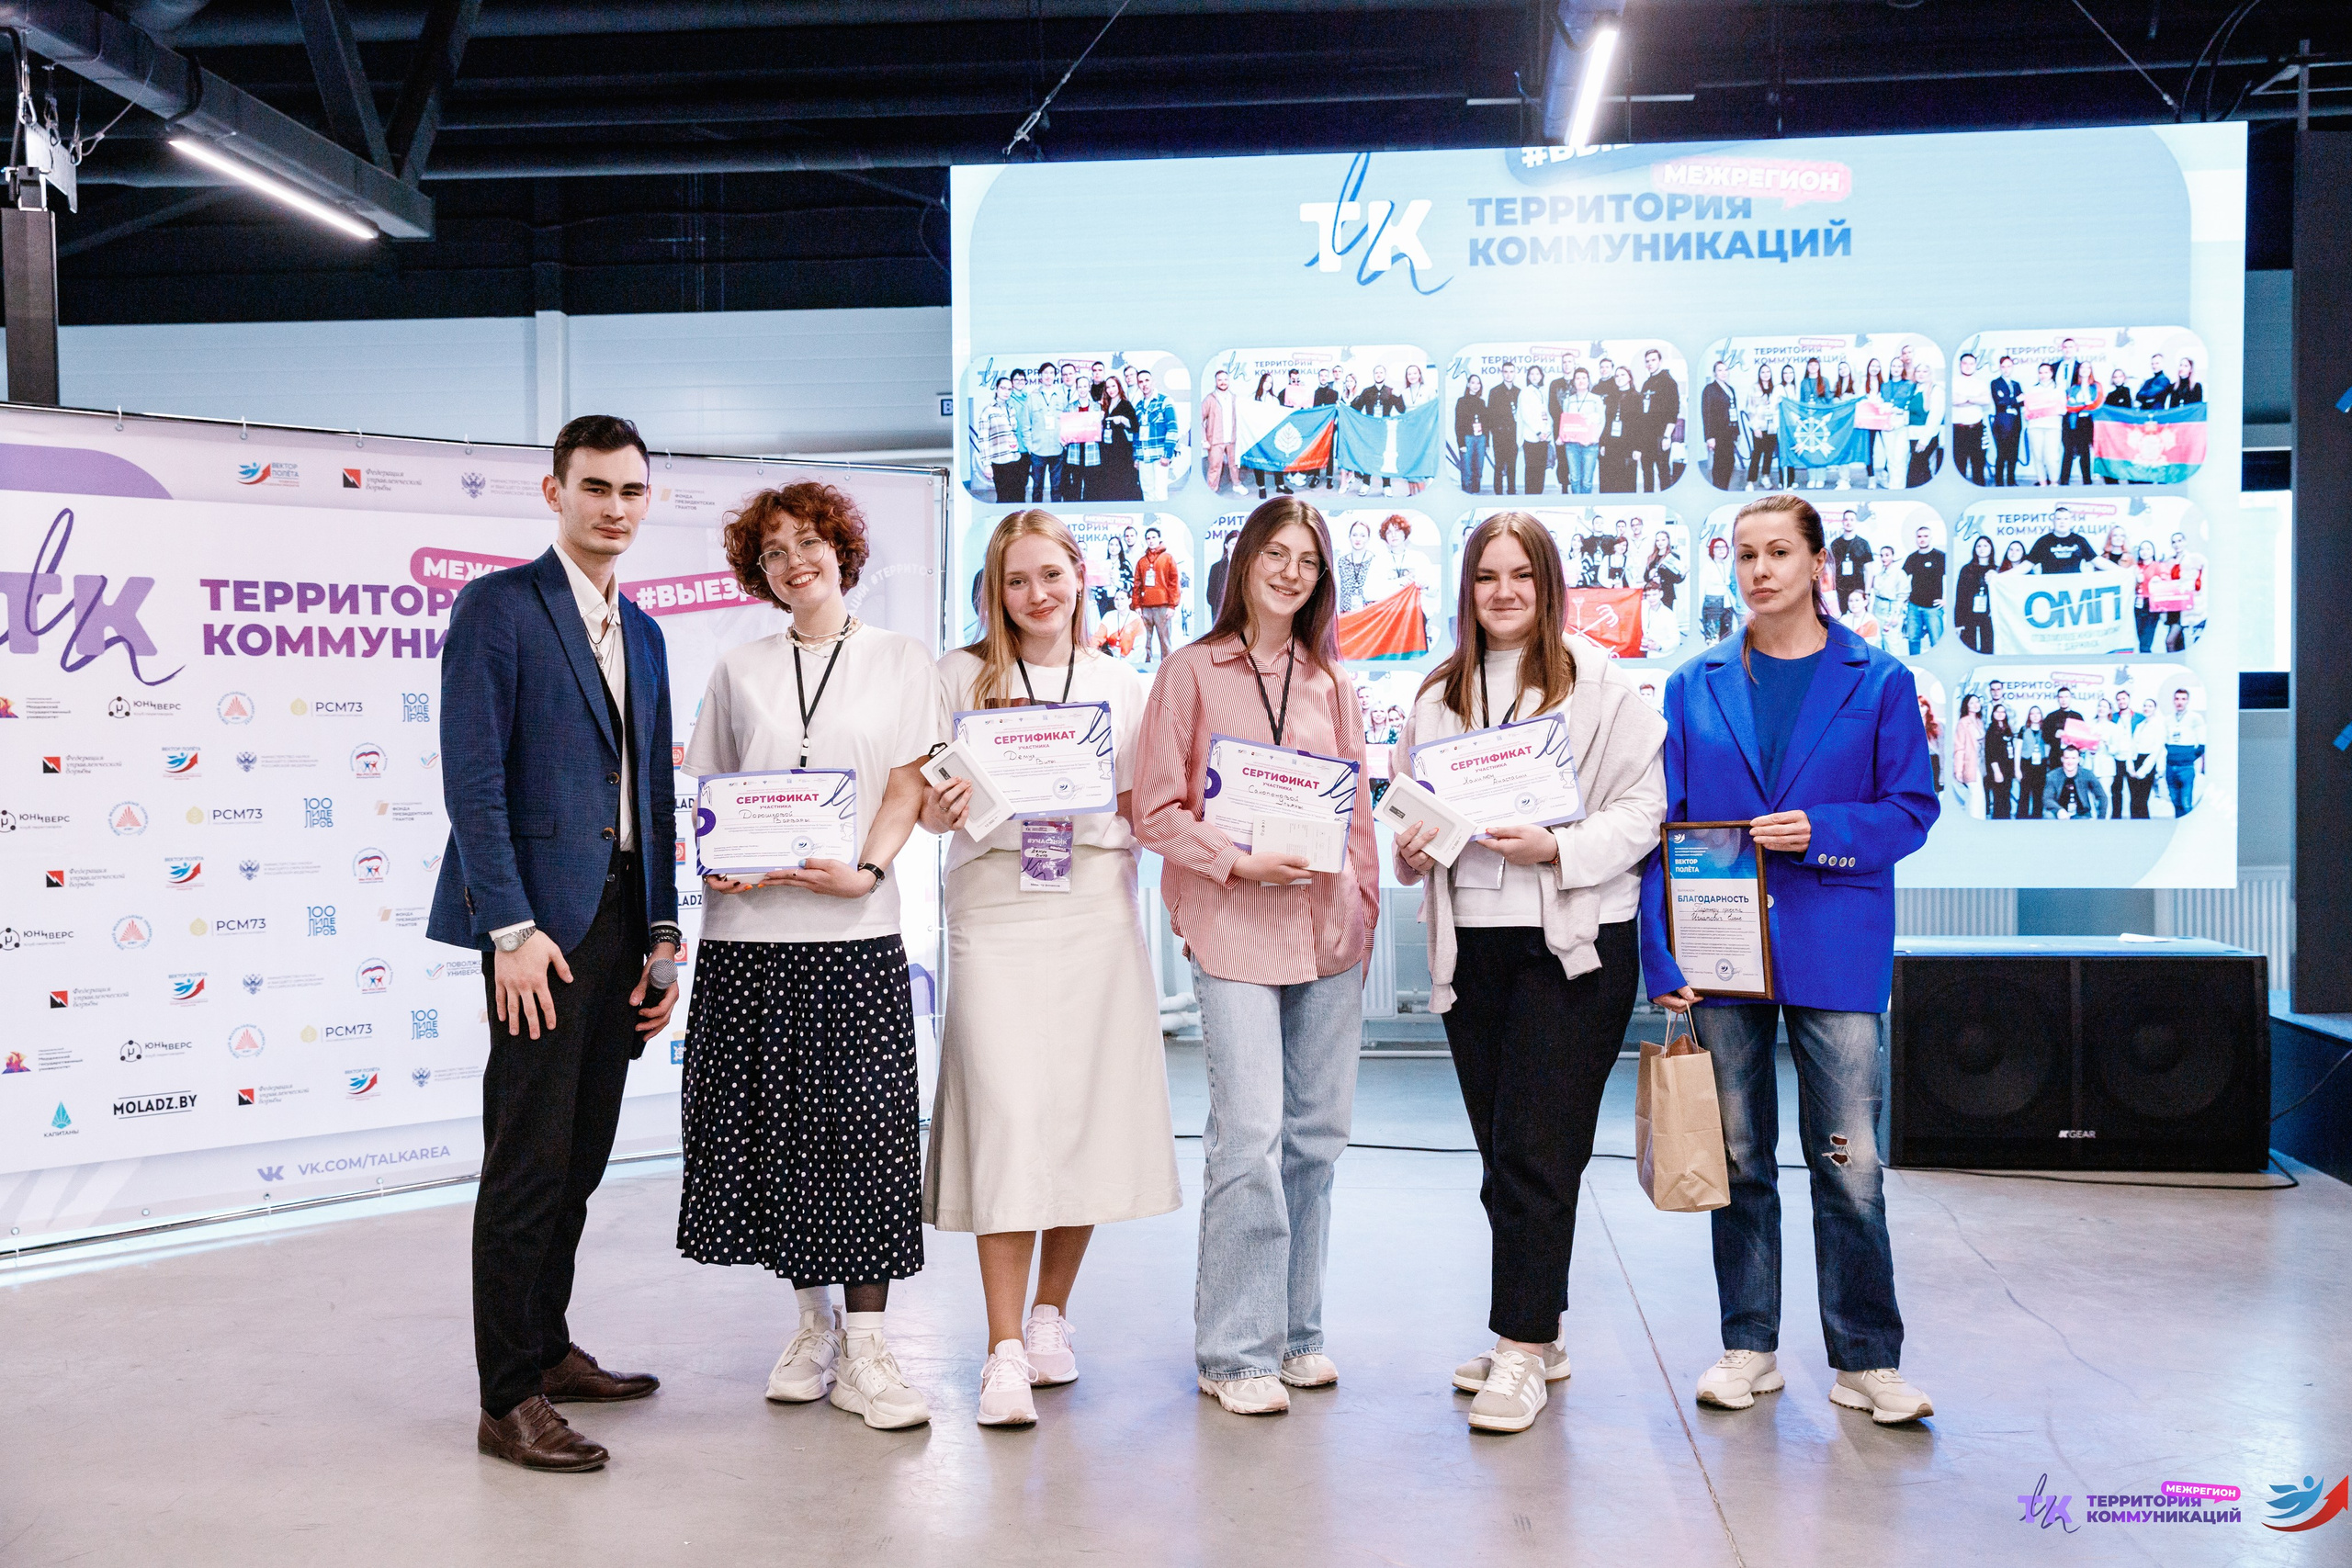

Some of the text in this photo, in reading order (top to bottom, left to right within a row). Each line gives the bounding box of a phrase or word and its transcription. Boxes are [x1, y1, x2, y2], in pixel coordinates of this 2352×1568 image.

[1663, 164, 1839, 191] МЕЖРЕГИОН
[1468, 192, 1752, 226] ТЕРРИТОРИЯ
[1468, 219, 1851, 266] КОММУНИКАЦИЙ
[424, 557, 509, 581] МЕЖ
[200, 579, 454, 616] ТЕРРИТОР
[636, 578, 757, 610] #ВЫЕЗ
[2025, 585, 2120, 628] ОМП
[202, 623, 448, 660] КОММУНИ
[401, 693, 429, 705] 100
[994, 730, 1076, 745] СЕРТИФИКАТ
[1451, 746, 1532, 772] СЕРТИФИКАТ
[1476, 762, 1508, 773] УЧАСТНИКА
[1242, 767, 1320, 790] СЕРТИФИКАТ
[1262, 782, 1293, 792] УЧАСТНИКА
[304, 797, 333, 810] 100
[736, 794, 820, 805] СЕРТИФИКАТ
[1678, 895, 1749, 904] БЛАГОДАРНОСТЬ
[307, 906, 336, 918] 100
[412, 1010, 438, 1021] 100
[113, 1094, 198, 1116] MOLADZ.BY
[43, 1129, 79, 1138] КАПИТАНЫ
[298, 1145, 451, 1176] VK.COM/TALKAREA
